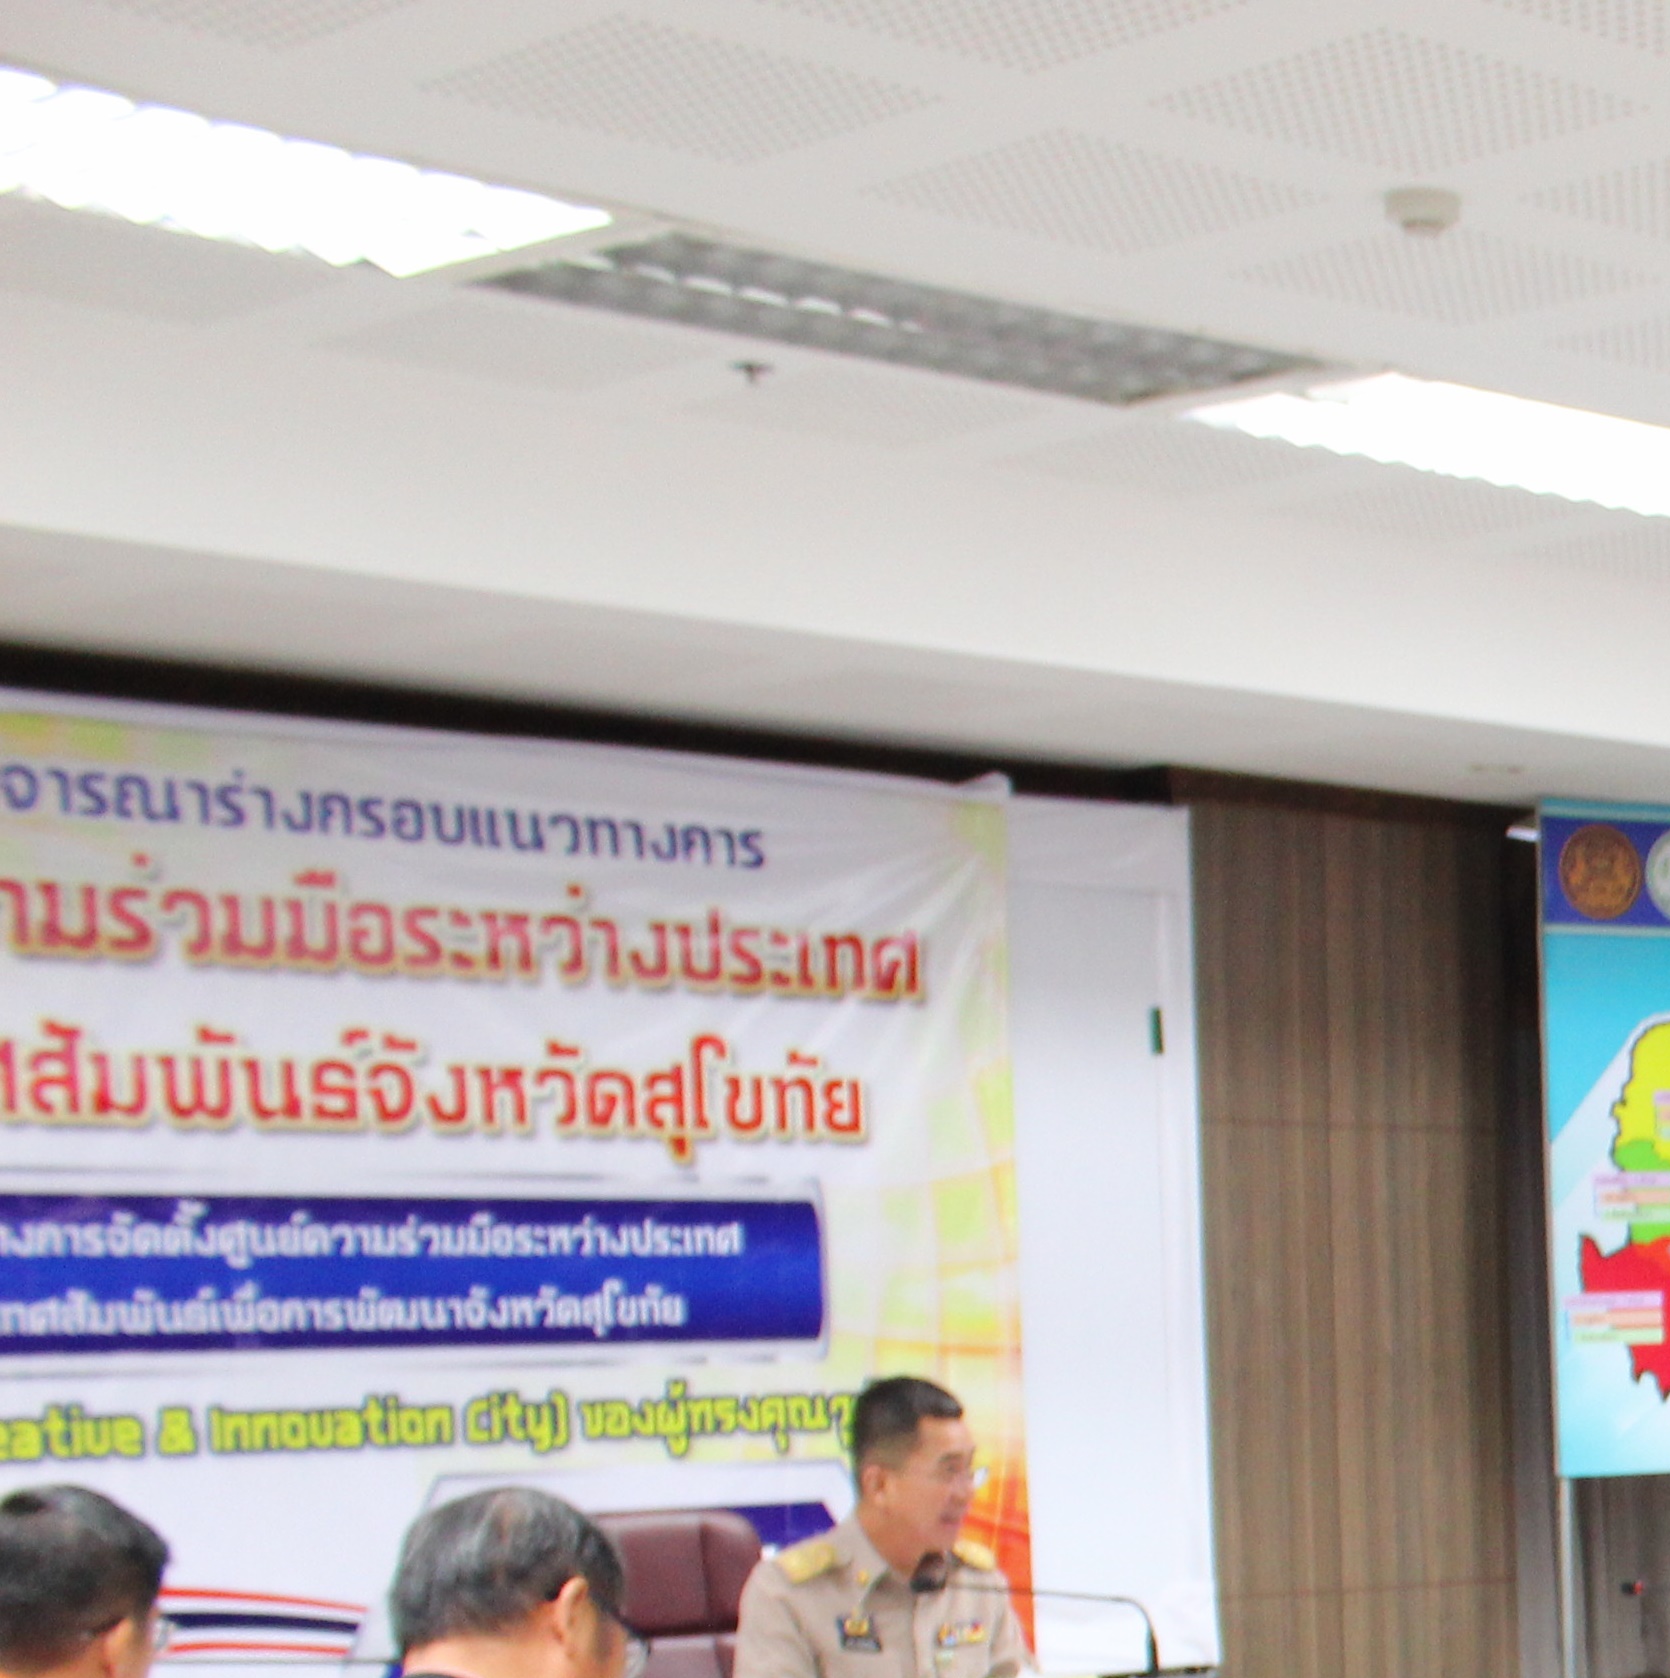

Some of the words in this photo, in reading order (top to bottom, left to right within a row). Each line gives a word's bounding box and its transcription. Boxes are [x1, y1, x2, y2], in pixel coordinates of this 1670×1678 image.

[158, 1404, 197, 1456] &
[208, 1392, 454, 1456] Innovation
[463, 1387, 570, 1454] City)
